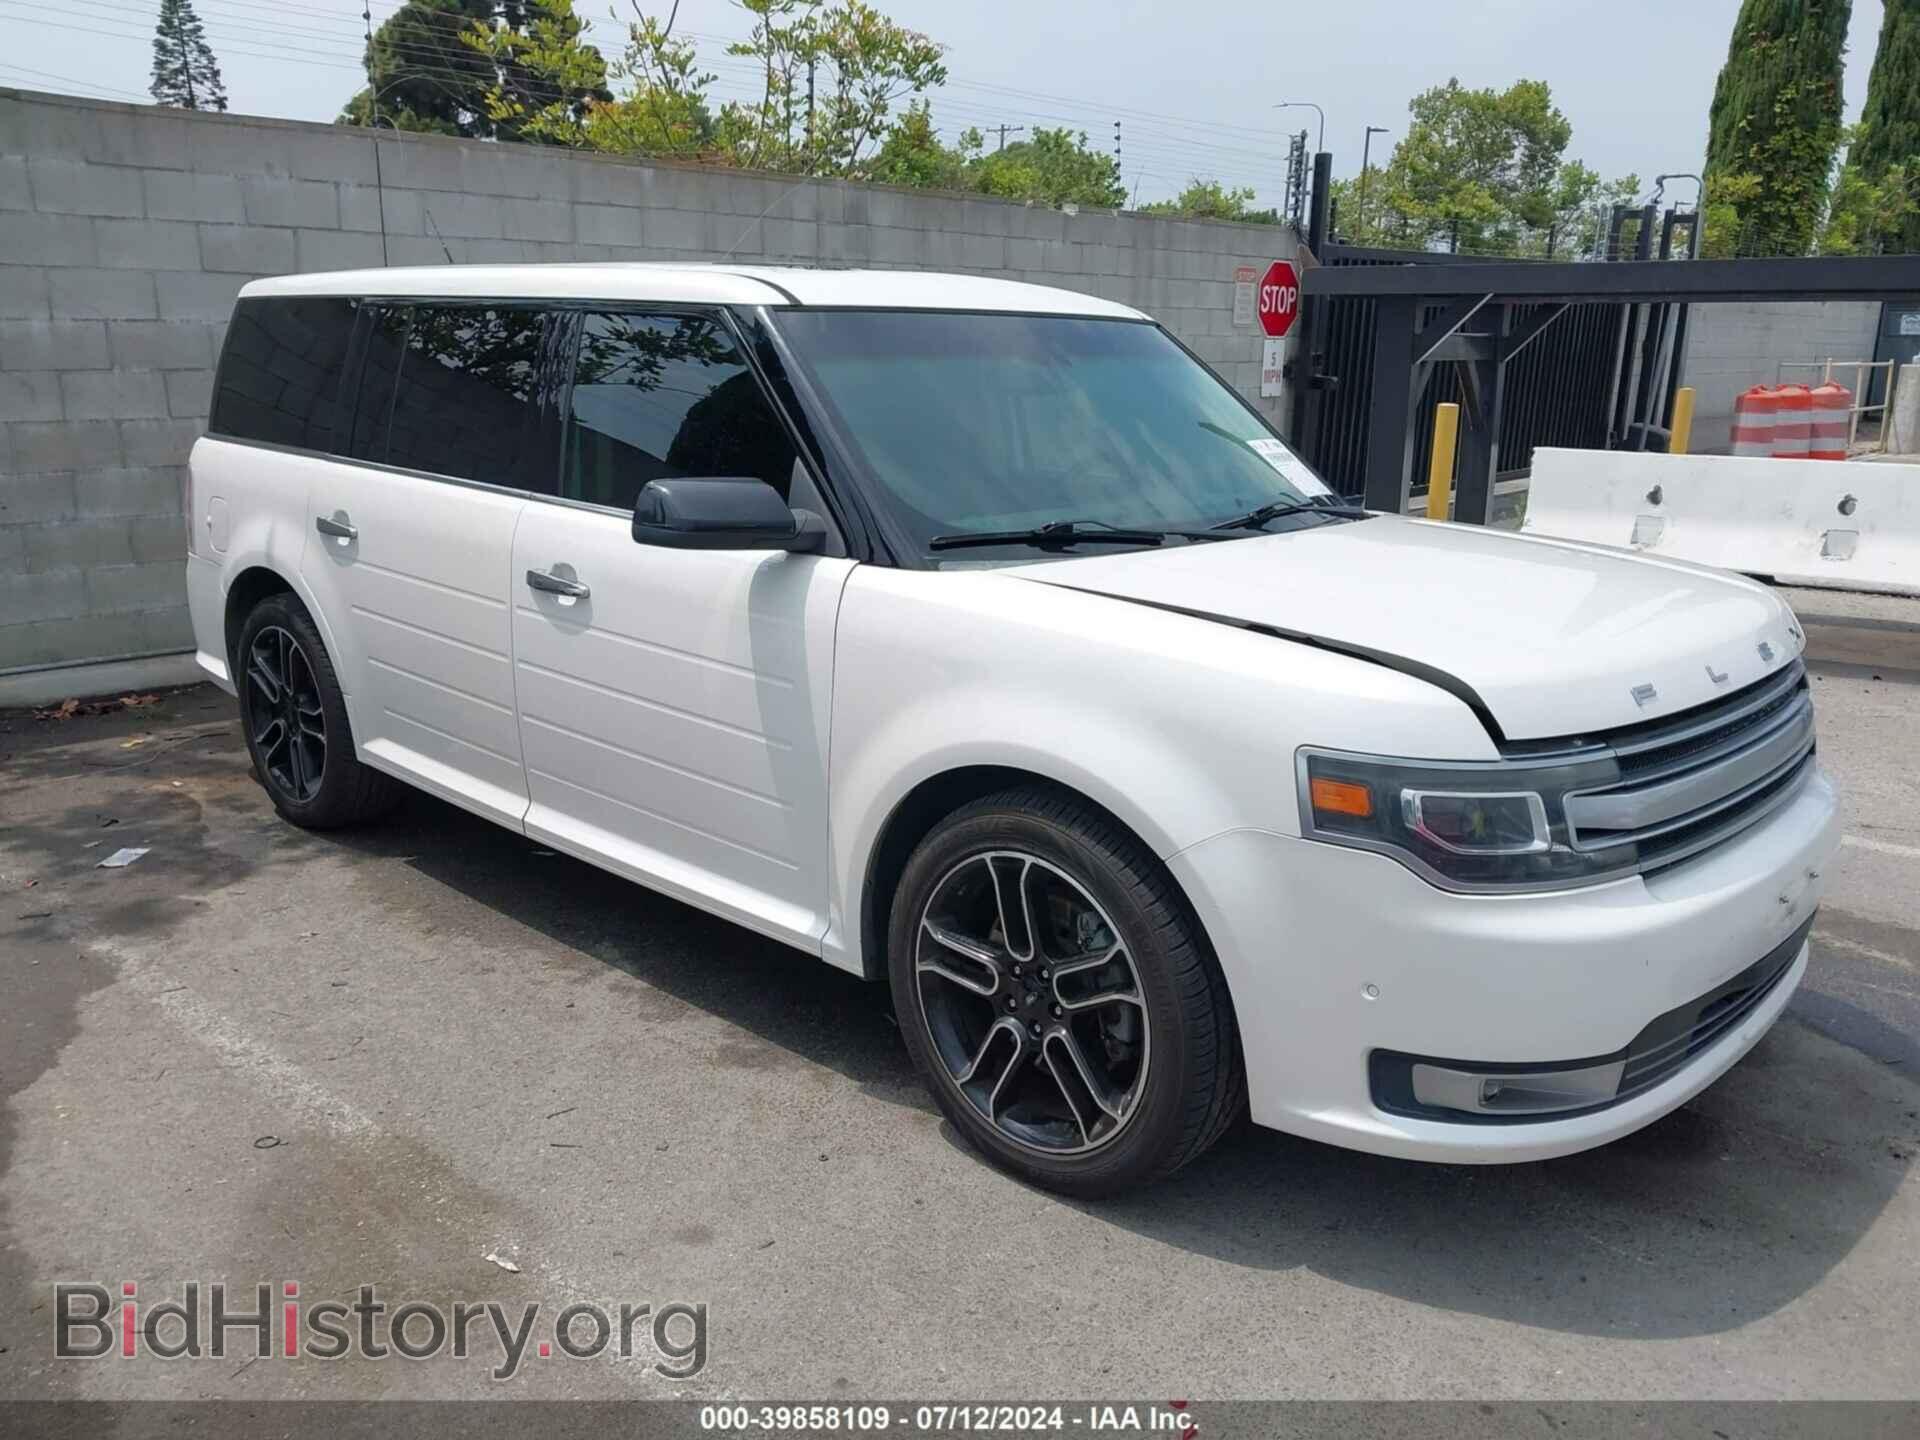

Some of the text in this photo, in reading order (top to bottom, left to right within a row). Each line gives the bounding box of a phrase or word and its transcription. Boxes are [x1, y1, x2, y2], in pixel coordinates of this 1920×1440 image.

[1260, 285, 1297, 314] STOP
[1271, 351, 1278, 367] 5
[1264, 369, 1281, 384] MPH
